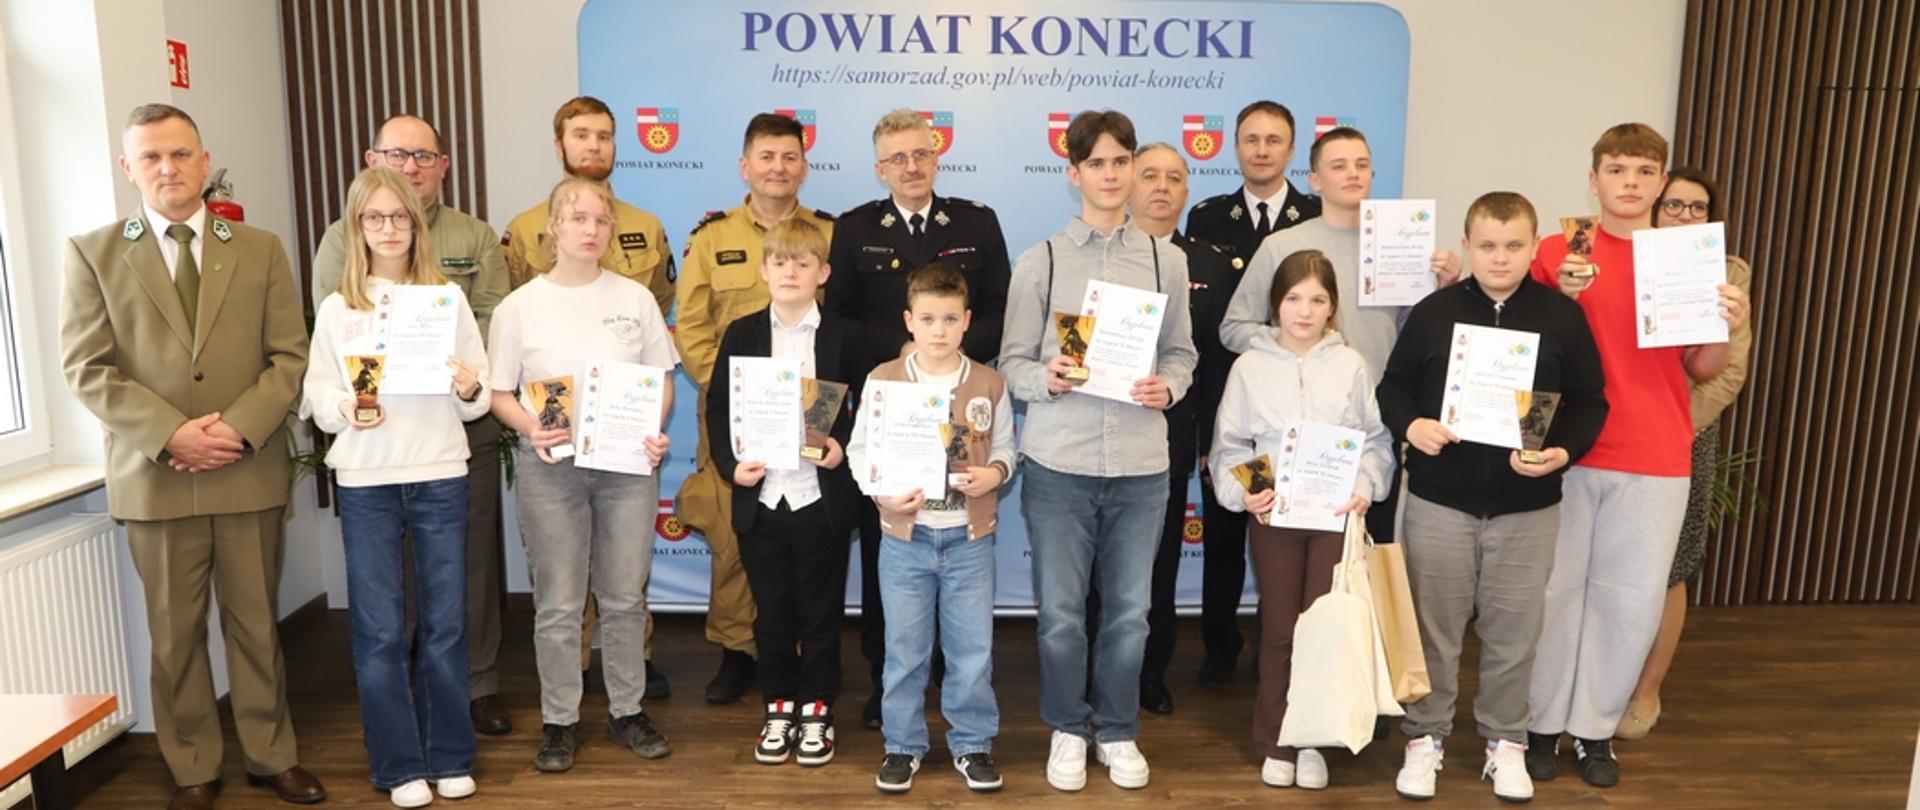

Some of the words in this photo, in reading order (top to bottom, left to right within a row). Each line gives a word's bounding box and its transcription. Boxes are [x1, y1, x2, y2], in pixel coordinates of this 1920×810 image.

[741, 12, 972, 54] POWIAT
[988, 15, 1256, 59] KONECKI
[771, 63, 1225, 92] https://samorzad.gov.pl/web/powiat-konecki
[615, 161, 654, 169] POWIAT
[656, 161, 704, 169] KONECKI
[809, 163, 840, 171] NECKI
[937, 164, 977, 172] ONECKI
[1024, 165, 1063, 174] POWIAT
[1199, 167, 1242, 176] KONECK
